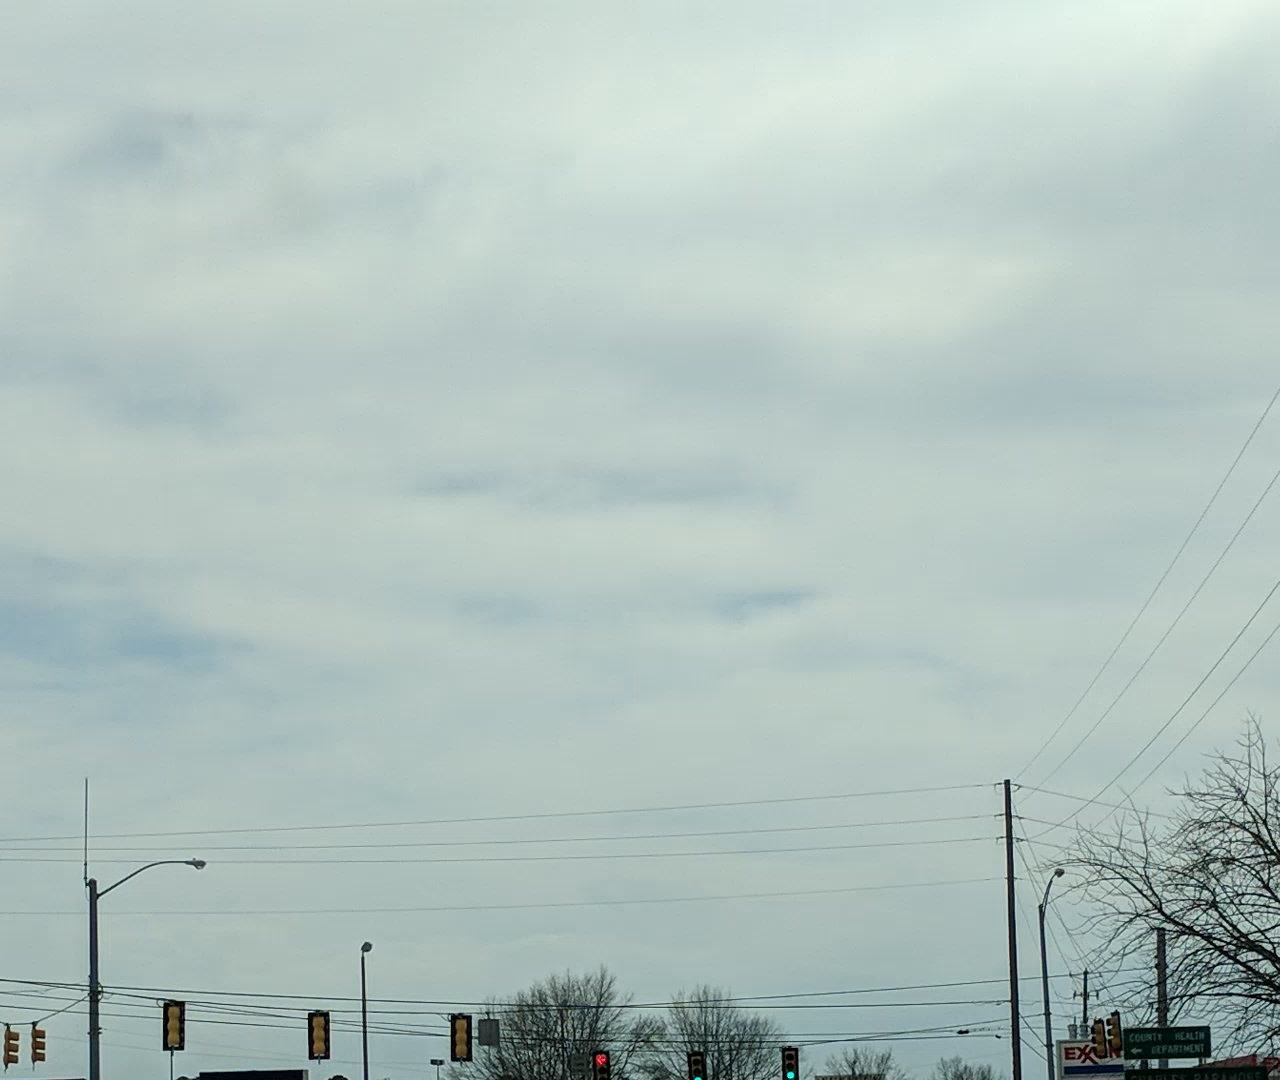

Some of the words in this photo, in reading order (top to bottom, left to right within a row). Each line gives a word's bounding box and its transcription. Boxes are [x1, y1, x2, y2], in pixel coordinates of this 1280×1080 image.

[1128, 1033, 1163, 1043] COUNTY
[1175, 1031, 1205, 1041] HEALTH
[1151, 1043, 1205, 1055] DEPARTMENT
